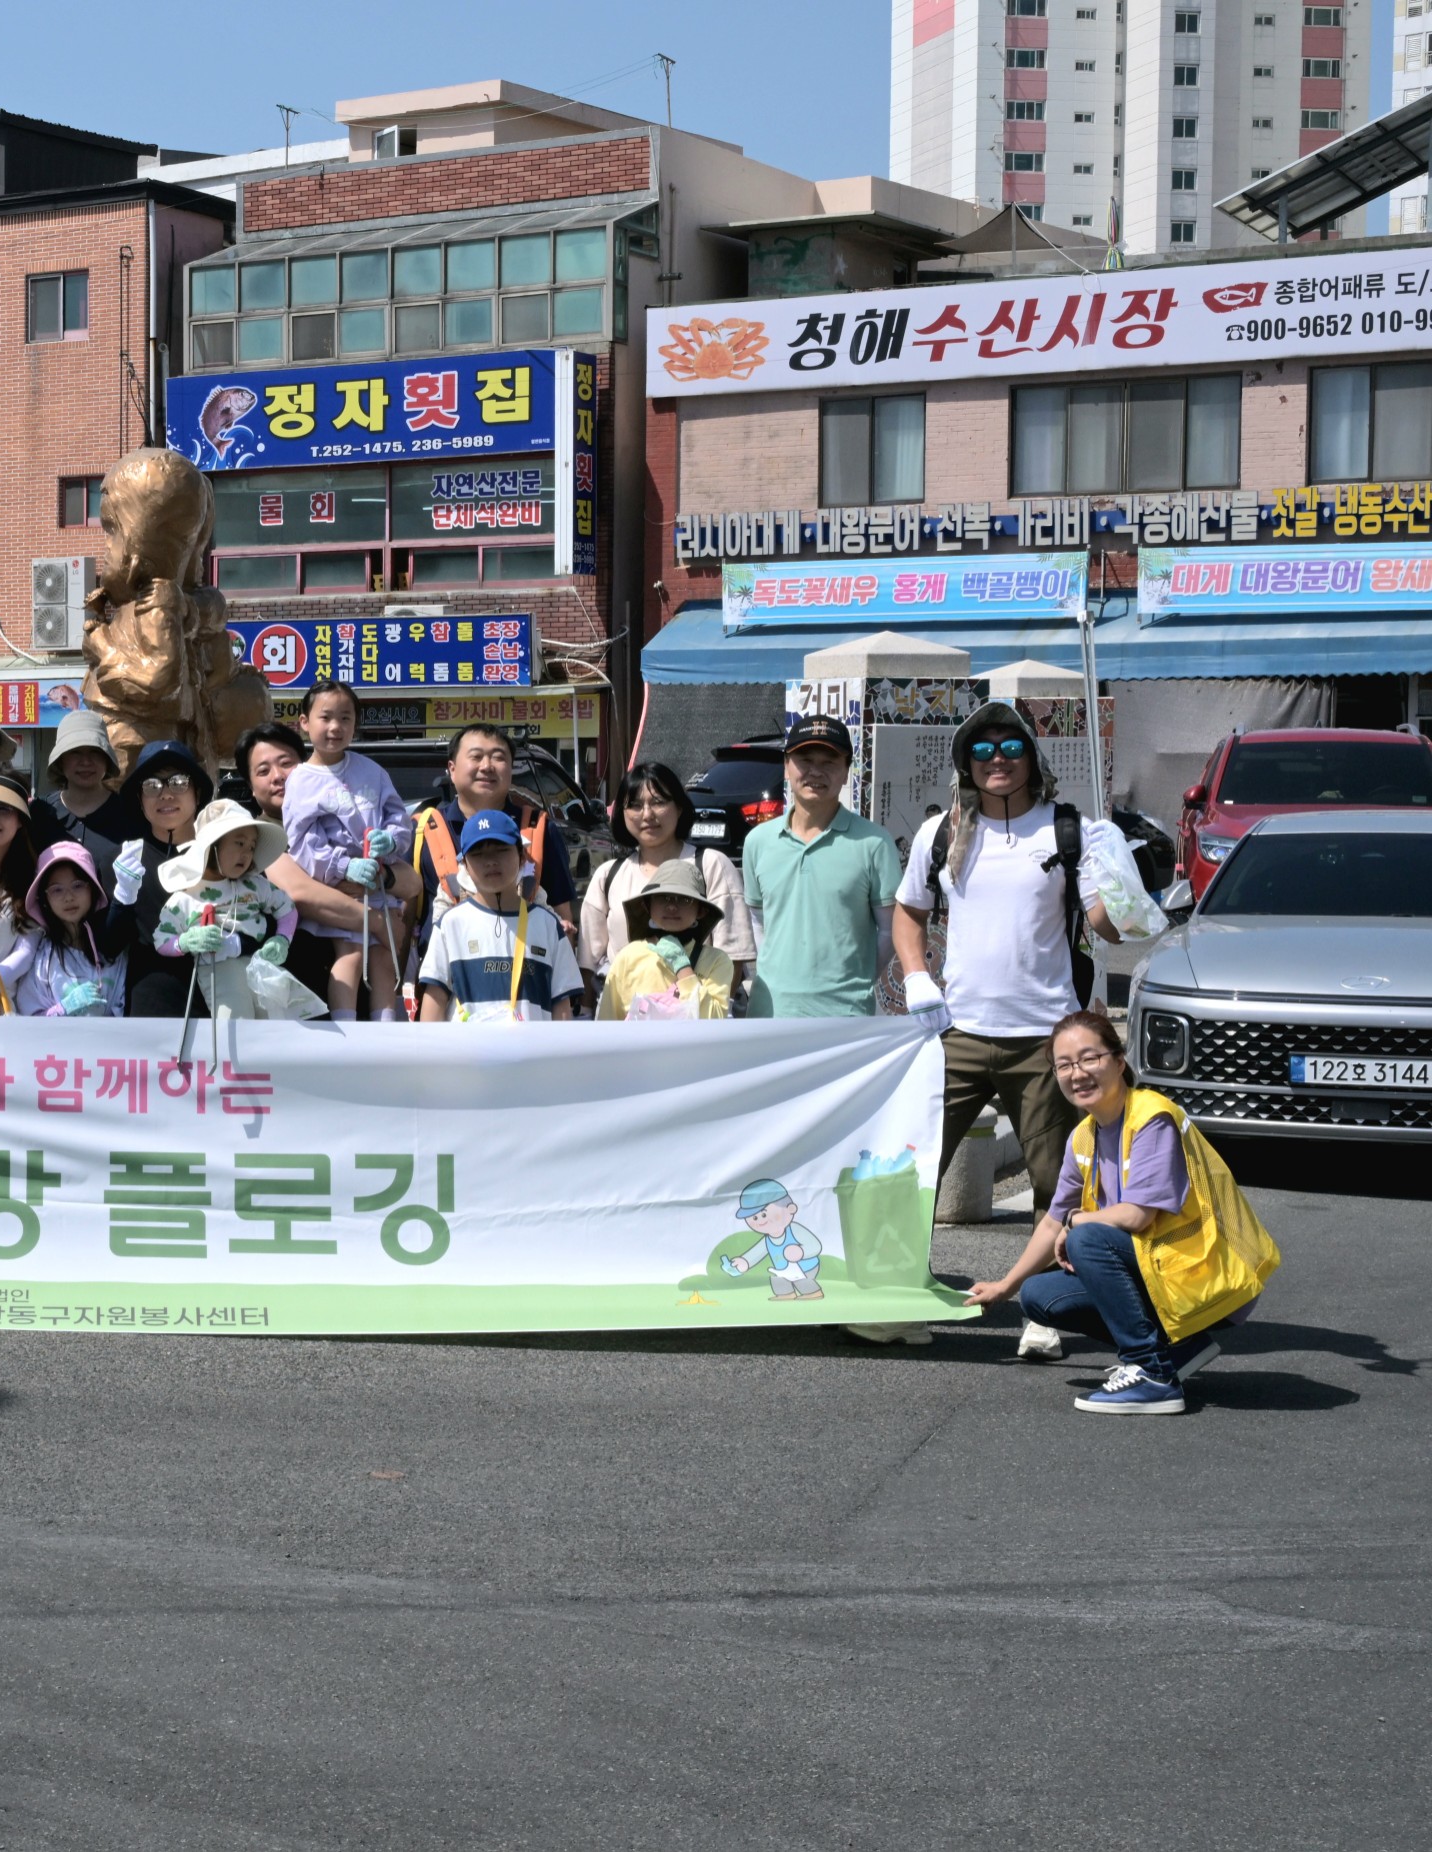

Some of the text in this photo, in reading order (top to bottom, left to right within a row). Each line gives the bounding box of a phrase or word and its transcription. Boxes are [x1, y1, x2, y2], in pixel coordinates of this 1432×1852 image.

[1274, 269, 1432, 305] 종합어패류 도/
[788, 288, 1178, 371] 청해수산시장
[1246, 307, 1432, 341] 900-9652 010-9
[263, 366, 532, 438] 정자횟집
[411, 435, 494, 452] 236-5989
[576, 363, 594, 536] 정자횟집
[431, 469, 542, 499] 자연산전문
[432, 500, 542, 529] 단체석완비
[676, 510, 802, 558] 러시아대게
[817, 505, 920, 554] 대왕문어
[937, 502, 991, 551] 전복
[1018, 496, 1090, 547] 가리비
[1115, 490, 1259, 545] 각종해산물
[1271, 487, 1321, 537] 젓갈
[753, 569, 1072, 607] 독도꽃새우 홍게 백골뱅이
[1170, 563, 1233, 596] 대게
[1239, 560, 1365, 595] 대왕문어
[262, 635, 296, 673] 회
[315, 625, 332, 681] 자연산
[337, 624, 356, 683] 참가자미
[361, 624, 379, 682] 도다리
[484, 643, 520, 660] 손님
[483, 663, 519, 681] 환영
[434, 700, 505, 722] 참가자미
[894, 686, 954, 718] 낙지
[34, 1052, 274, 1115] 함께하는
[1309, 1060, 1429, 1084] 122호 3144
[103, 1151, 455, 1265] 플로깅
